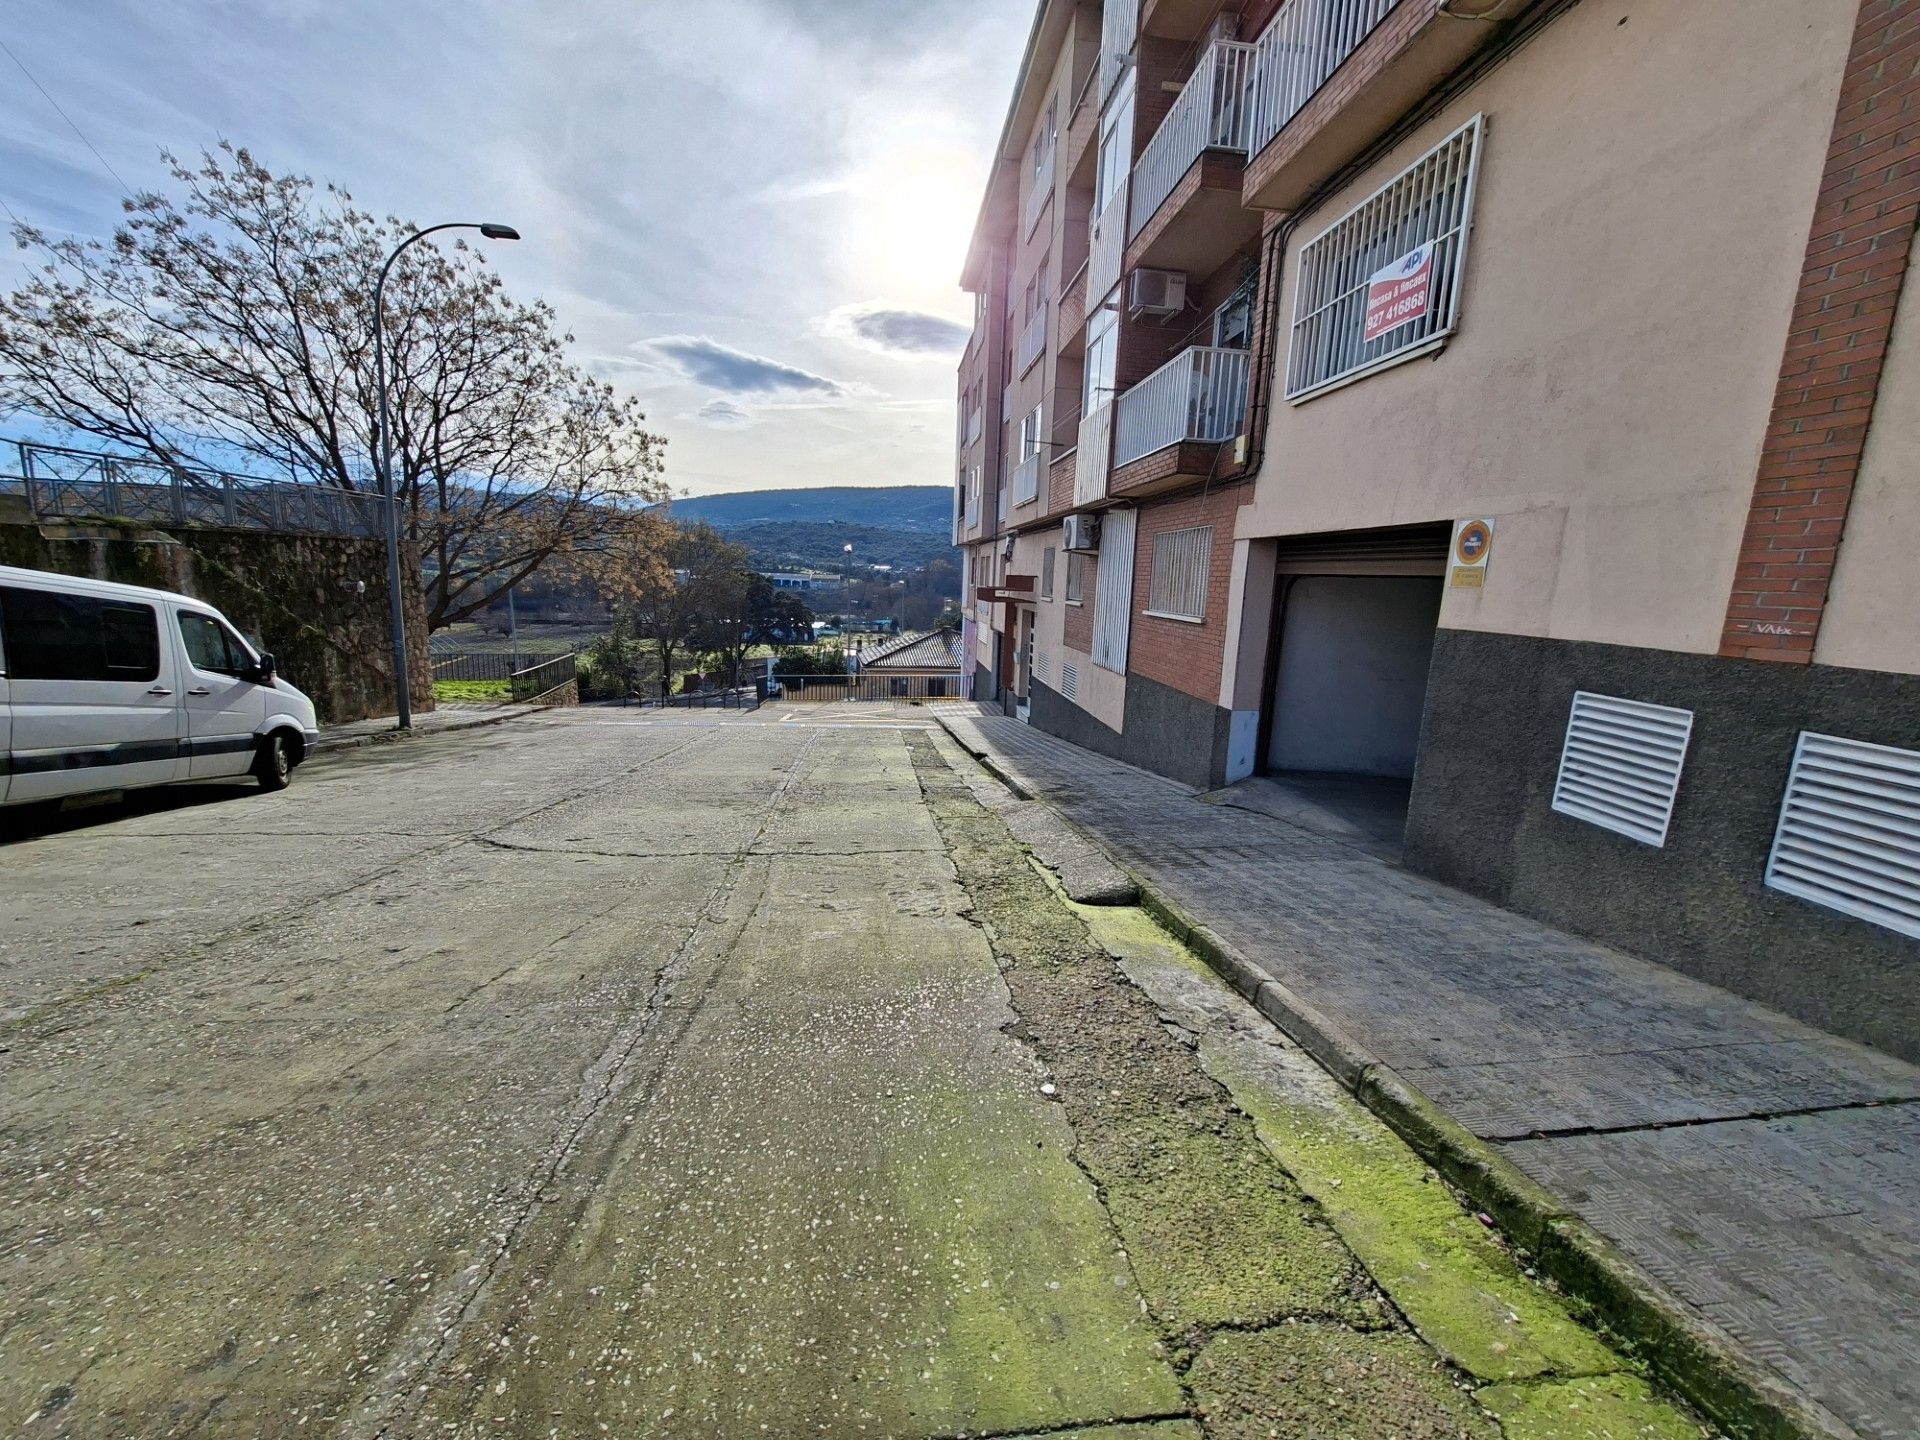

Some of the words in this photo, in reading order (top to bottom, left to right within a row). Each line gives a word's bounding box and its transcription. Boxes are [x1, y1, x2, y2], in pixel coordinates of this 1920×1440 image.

[1402, 249, 1423, 273] API
[1367, 310, 1384, 330] 927
[1386, 290, 1425, 320] 416868
